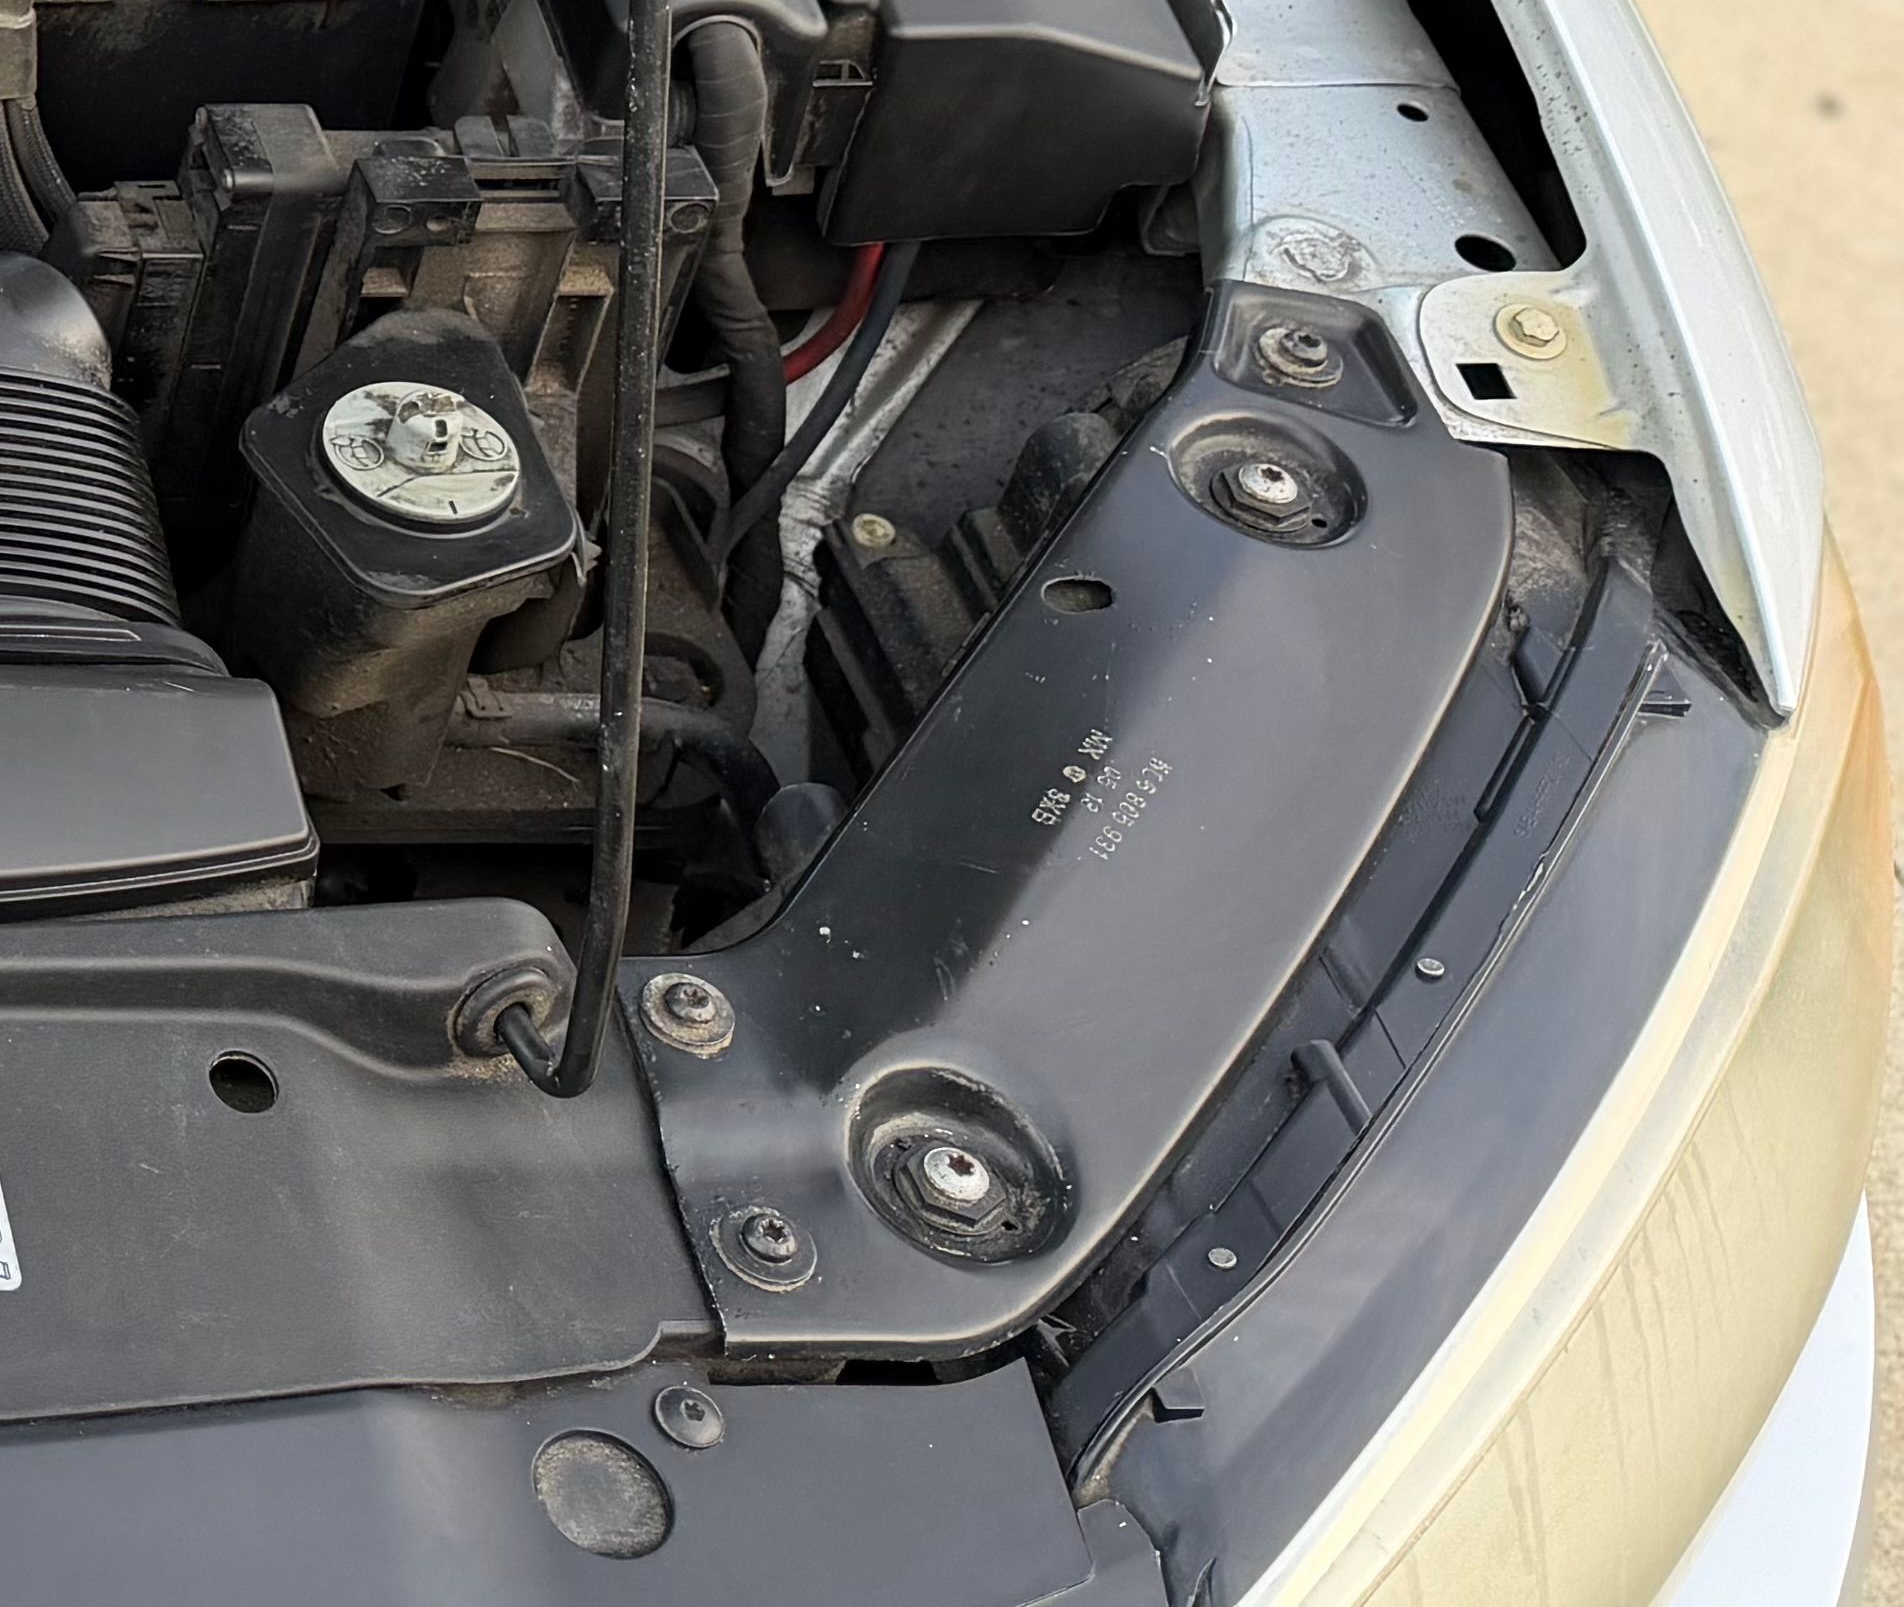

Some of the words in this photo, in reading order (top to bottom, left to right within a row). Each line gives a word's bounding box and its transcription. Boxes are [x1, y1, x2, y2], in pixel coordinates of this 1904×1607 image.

[1077, 728, 1113, 760] MX
[1111, 792, 1146, 826] 805
[1089, 825, 1123, 860] 931
